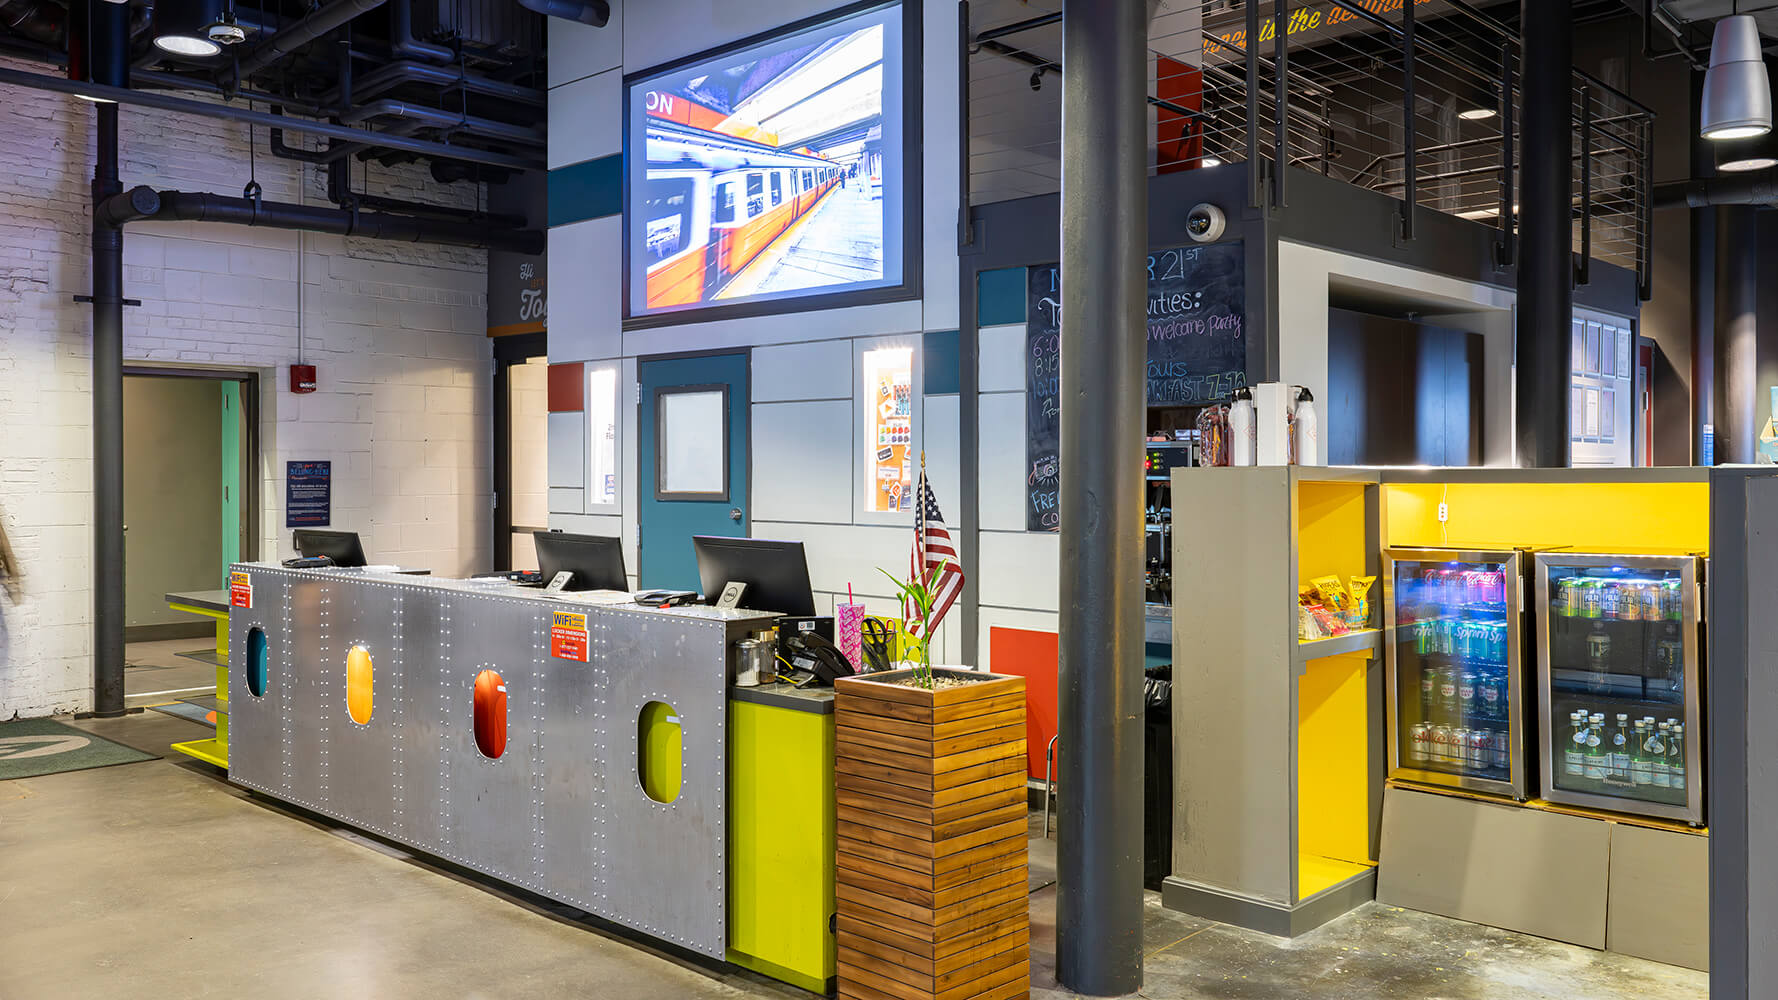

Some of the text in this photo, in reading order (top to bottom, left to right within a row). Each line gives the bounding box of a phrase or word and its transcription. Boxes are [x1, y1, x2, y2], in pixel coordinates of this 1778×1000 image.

[1258, 19, 1276, 42] is
[1287, 8, 1321, 36] the
[519, 262, 535, 280] Hi
[1032, 334, 1060, 358] 6:0
[1032, 376, 1060, 401] 10:0
[553, 613, 572, 627] WiFi
